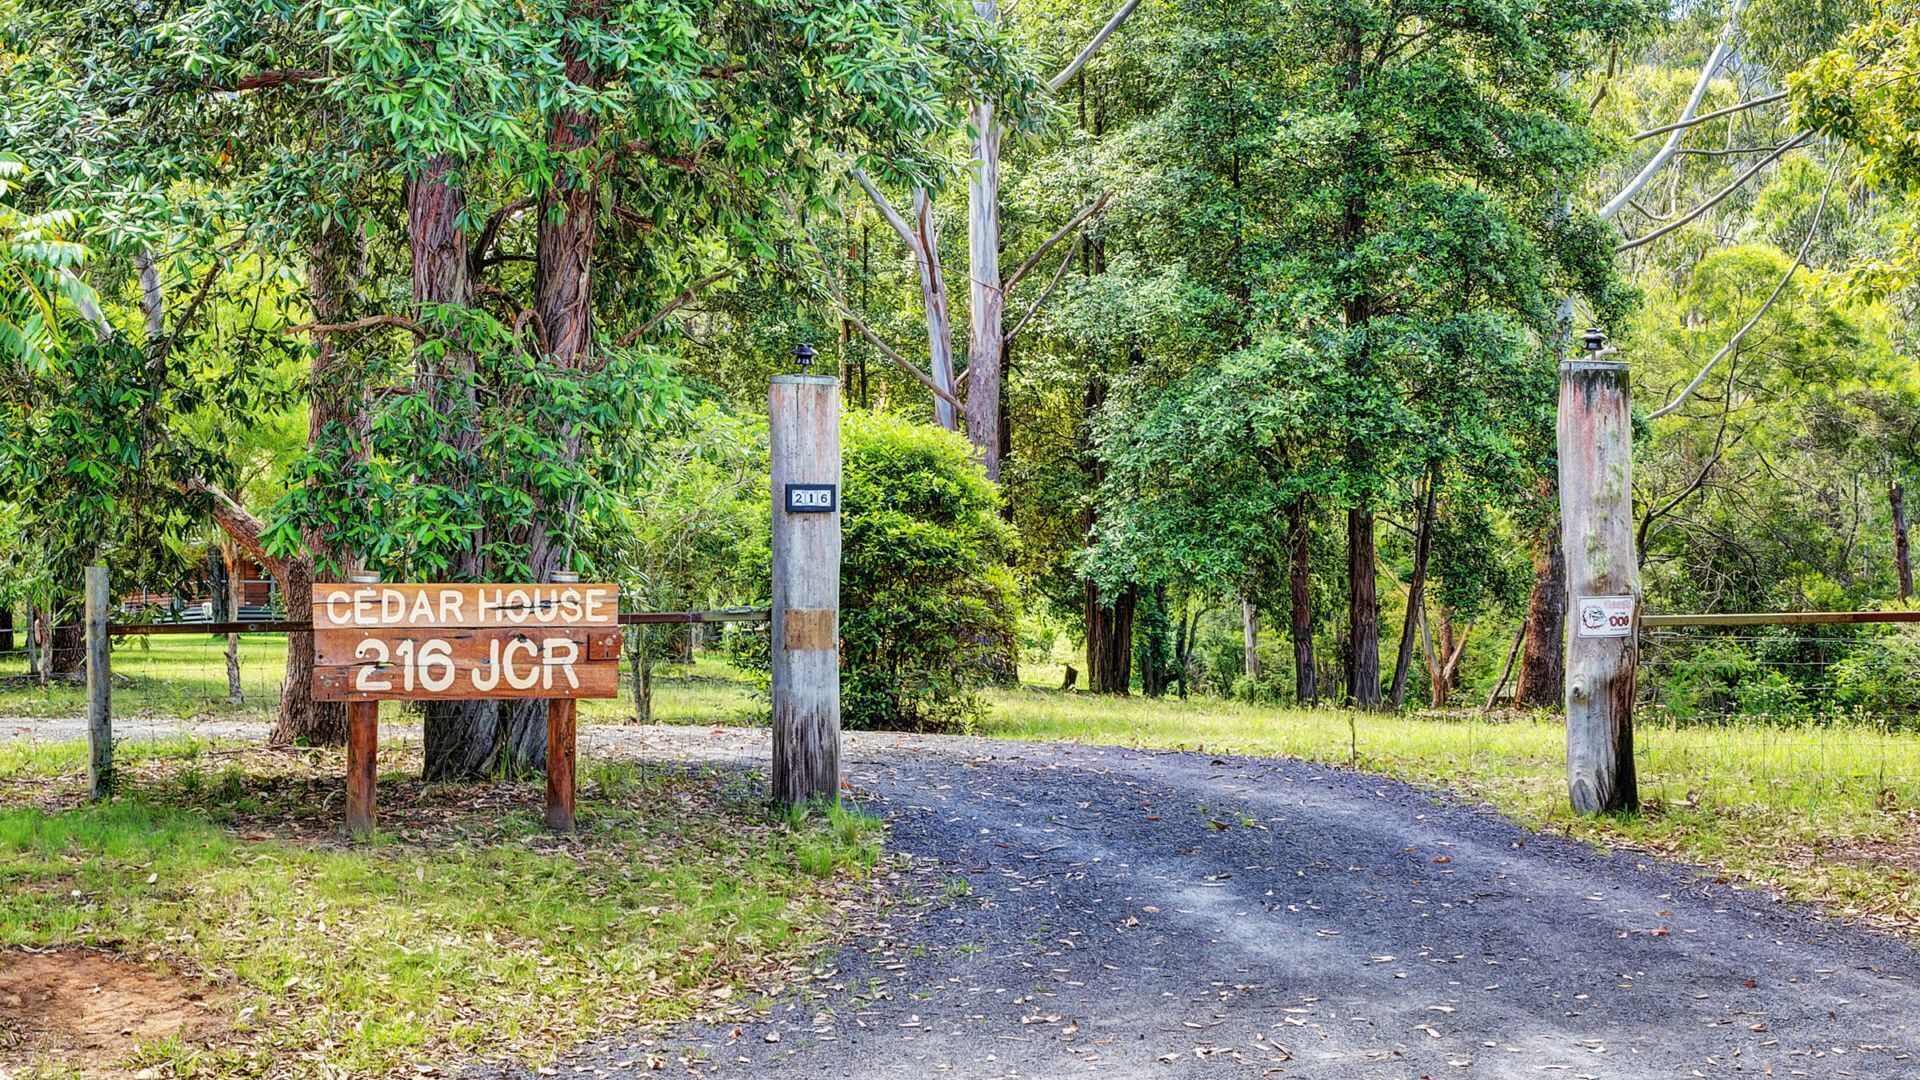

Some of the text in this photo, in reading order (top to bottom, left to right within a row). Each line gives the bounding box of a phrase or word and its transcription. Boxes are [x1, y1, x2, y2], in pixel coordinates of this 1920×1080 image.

[795, 493, 828, 503] 216
[326, 588, 608, 624] CEDAR HOUSE
[355, 638, 580, 692] 216 JCR
